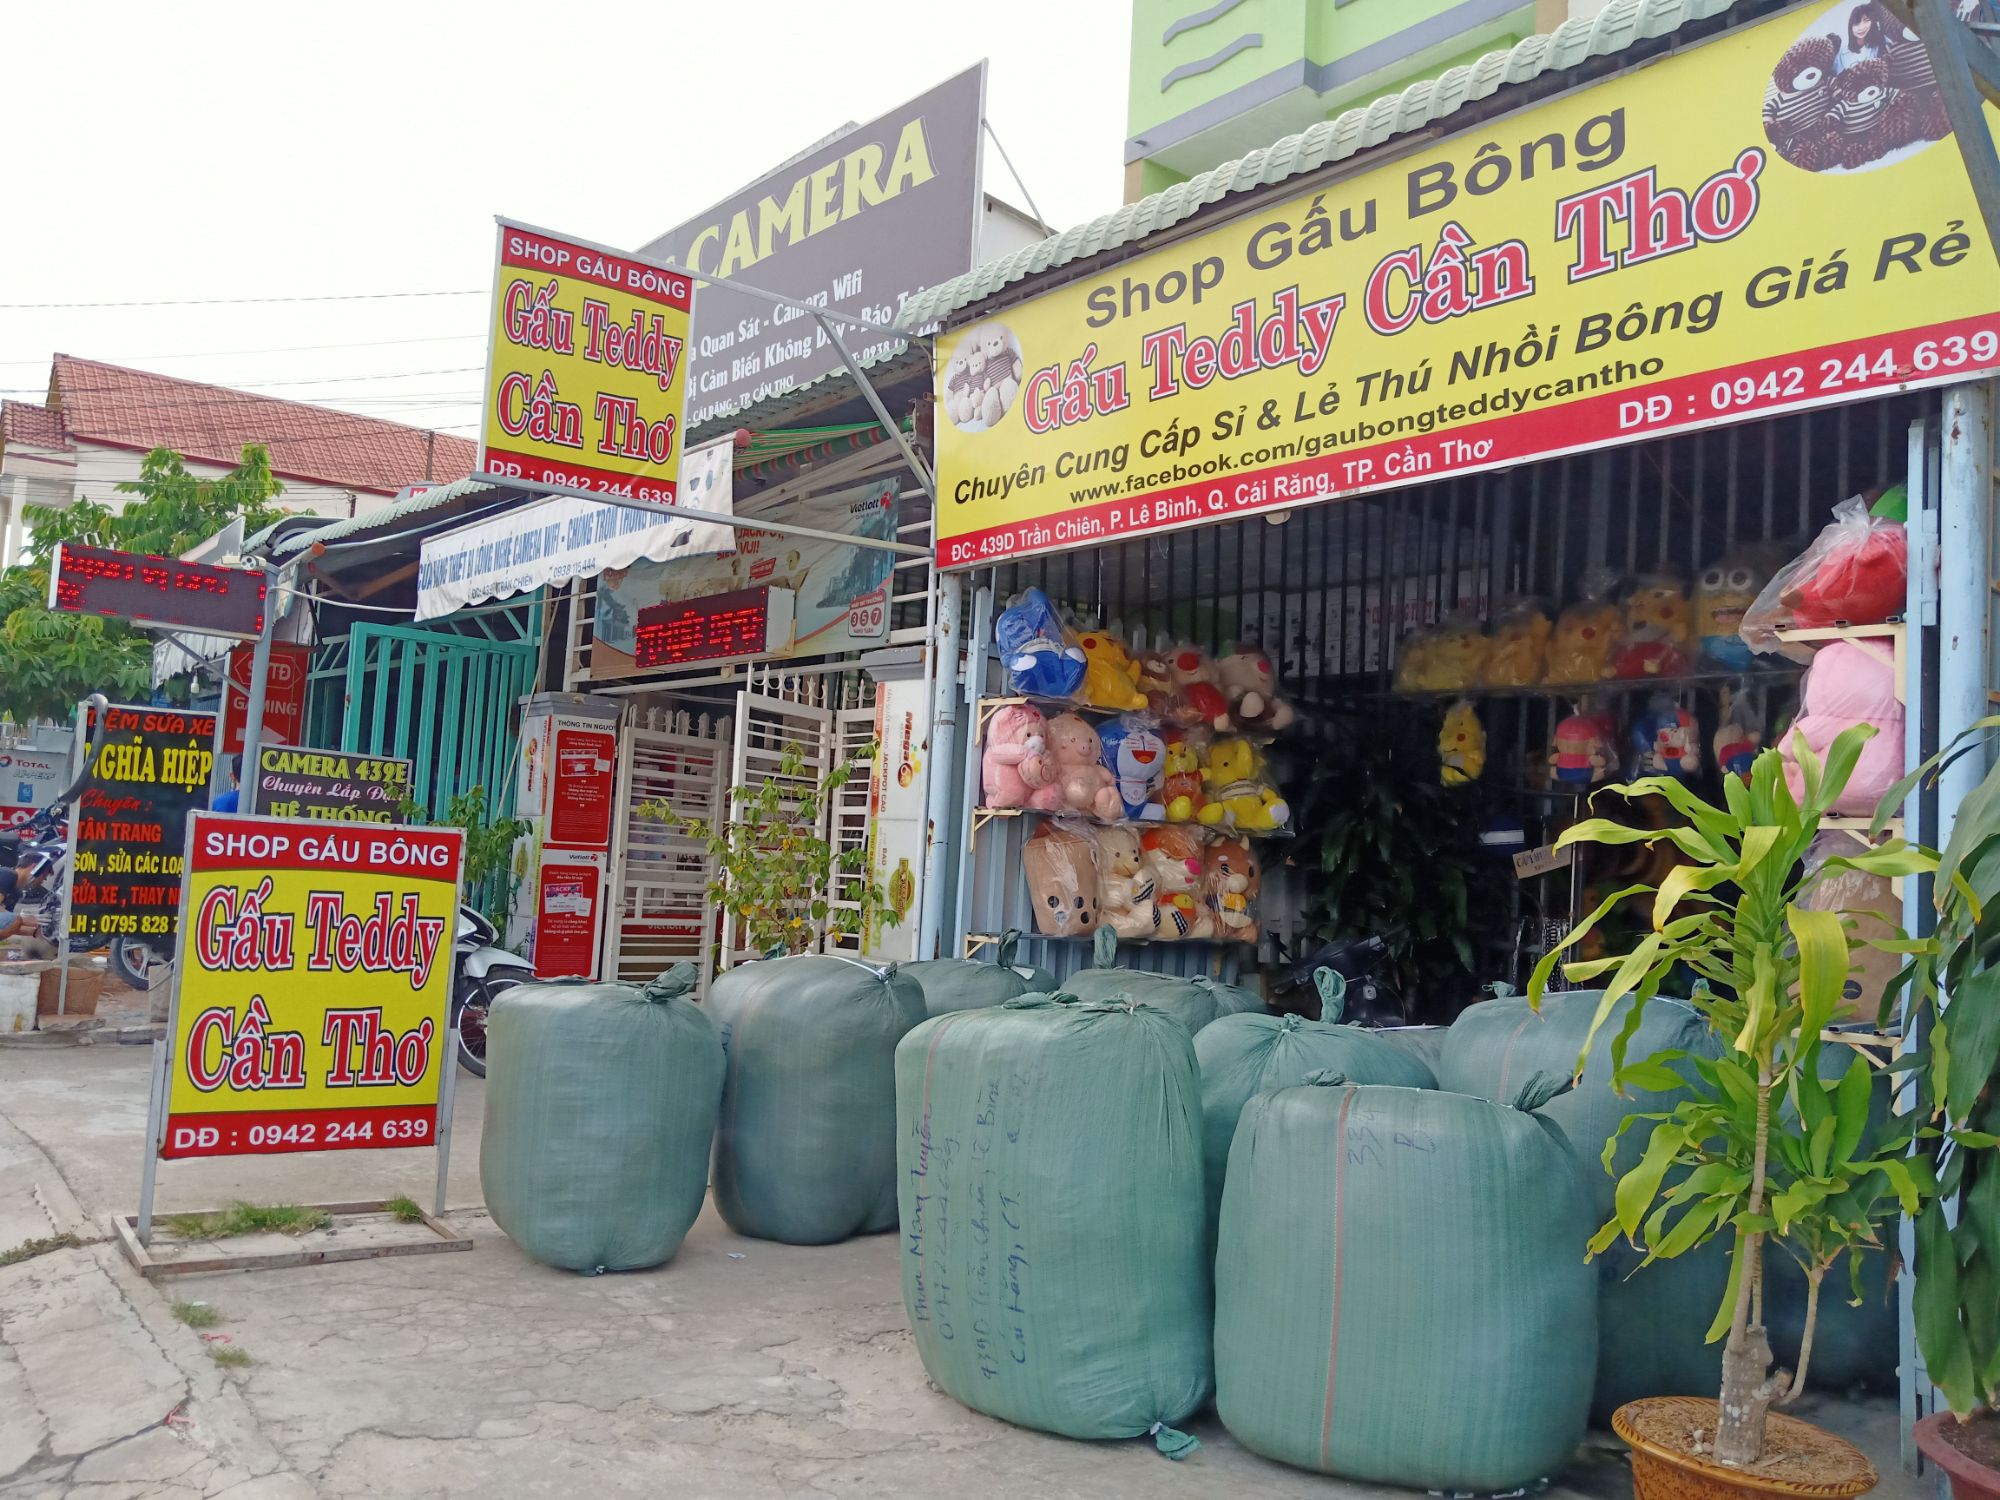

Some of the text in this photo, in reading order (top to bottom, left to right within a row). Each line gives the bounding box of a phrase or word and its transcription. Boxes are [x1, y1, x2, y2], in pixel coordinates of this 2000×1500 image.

[686, 115, 940, 290] CAMERA
[1086, 107, 1627, 328] Shop Gấu Bông
[510, 236, 686, 300] SHOP GẤU BÔNG
[1025, 146, 1766, 435] Gấu Teddy Cần Thơ
[504, 279, 683, 392] Gấu Teddy
[700, 331, 734, 358] Quan
[738, 317, 760, 343] Sát
[832, 268, 863, 302] Wifi
[700, 369, 728, 393] Cảm
[732, 351, 761, 382] Biến
[764, 336, 812, 369] Không
[954, 220, 1971, 504] Chuyên Cung Cấp Sỉ & Lẻ Thú Nhồi Bông Giá Rẻ
[1619, 330, 1999, 429] DĐ : 0942 244 639
[497, 369, 675, 465] Cần Thơ
[1069, 356, 1664, 504] www.facebook.com/gaubongteddycantho
[489, 458, 522, 479] DĐ
[542, 469, 591, 491] 0942
[597, 480, 633, 499] 244
[639, 487, 673, 505] 639
[850, 498, 879, 515] Vietlott
[951, 438, 1494, 562] ĐC: 439D Trần Chiên, P. Lê Bình, Q. Cái Răng, TP. Cần Thơ
[188, 718, 215, 736] XE
[582, 722, 593, 730] TIN
[903, 711, 912, 761] Mega
[160, 738, 213, 794] HIỆP
[261, 750, 408, 784] CAMERA 439E
[262, 775, 323, 796] Chuyên
[326, 781, 362, 801] Lắp
[111, 822, 163, 843] TRANG
[205, 831, 450, 867] SHOP GẤU BÔNG
[107, 847, 132, 873] SỬA
[135, 850, 160, 875] CÁC
[100, 886, 119, 905] XE
[131, 886, 166, 906] THAY
[100, 914, 138, 934] 0795
[141, 915, 169, 934] 828
[196, 875, 295, 971] Gấu
[305, 890, 445, 990] Teddy
[186, 994, 434, 1092] Cần Thơ
[174, 1119, 429, 1150] DĐ : 0942 244 639
